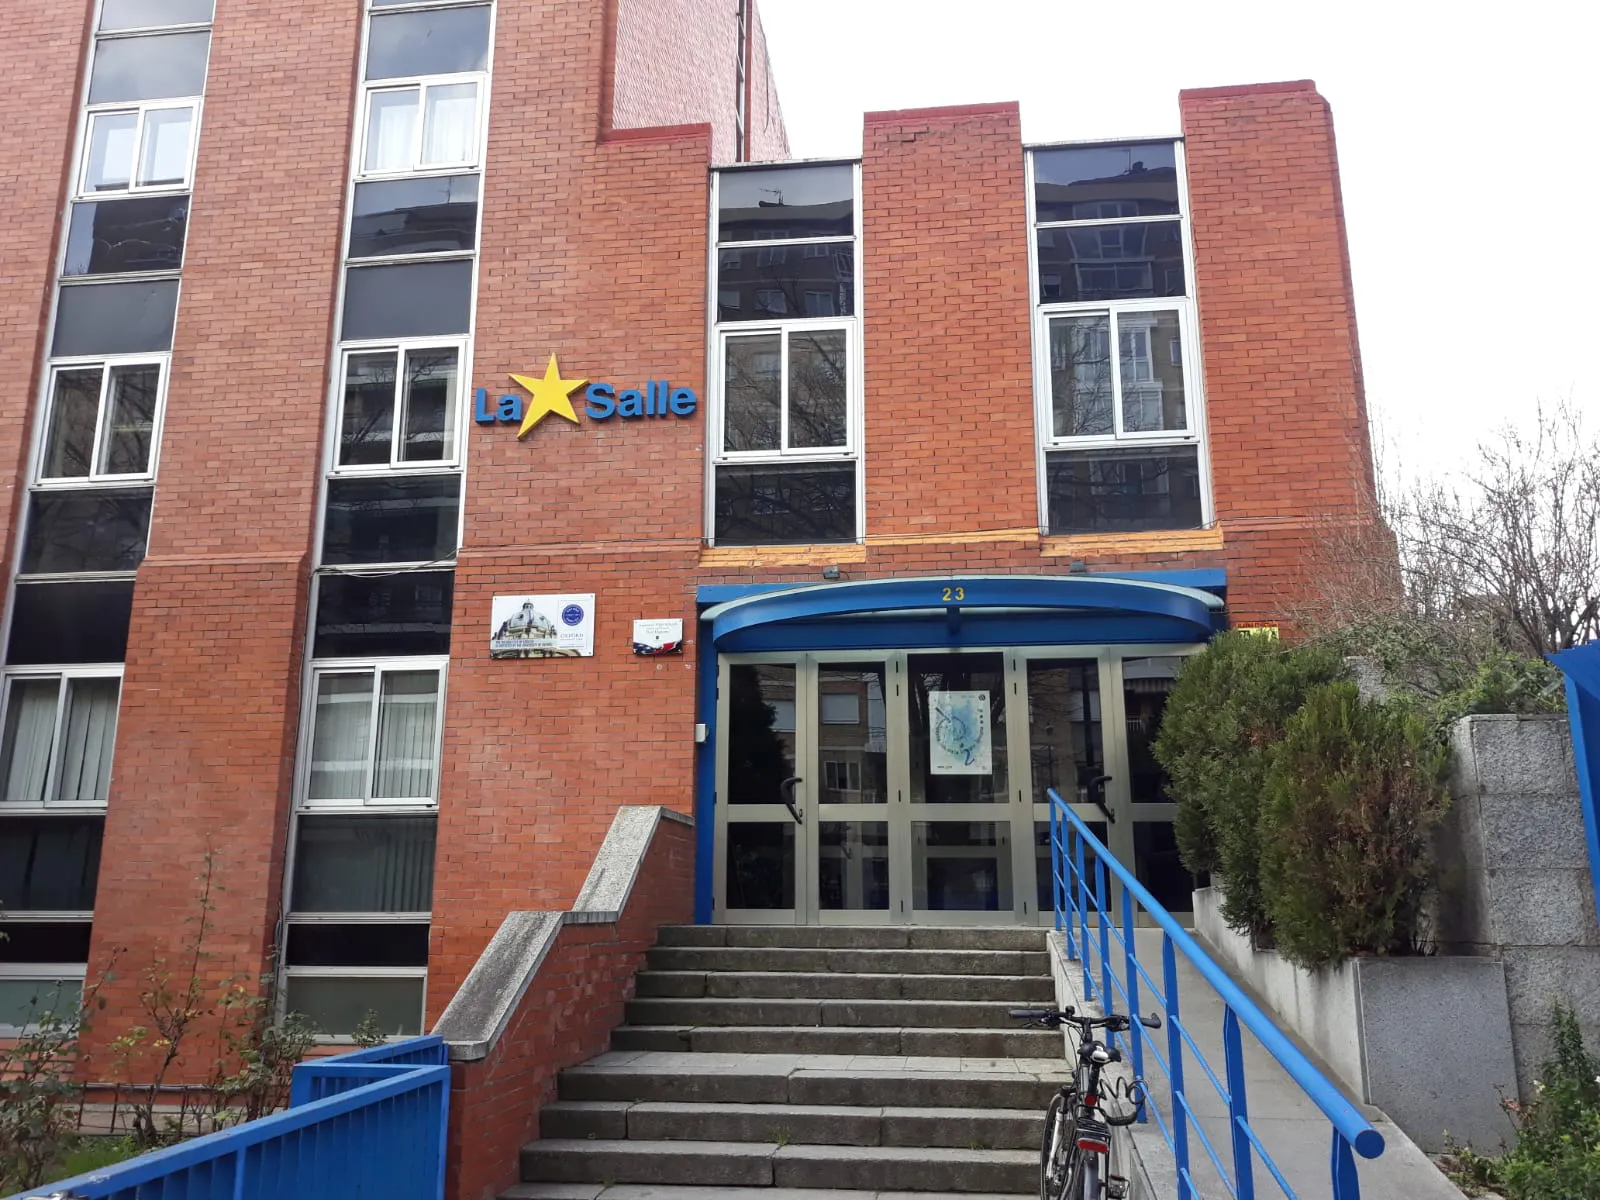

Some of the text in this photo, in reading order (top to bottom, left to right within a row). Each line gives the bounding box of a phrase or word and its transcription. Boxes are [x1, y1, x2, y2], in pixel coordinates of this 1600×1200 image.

[475, 380, 697, 423] La Salle
[942, 587, 965, 601] 23
